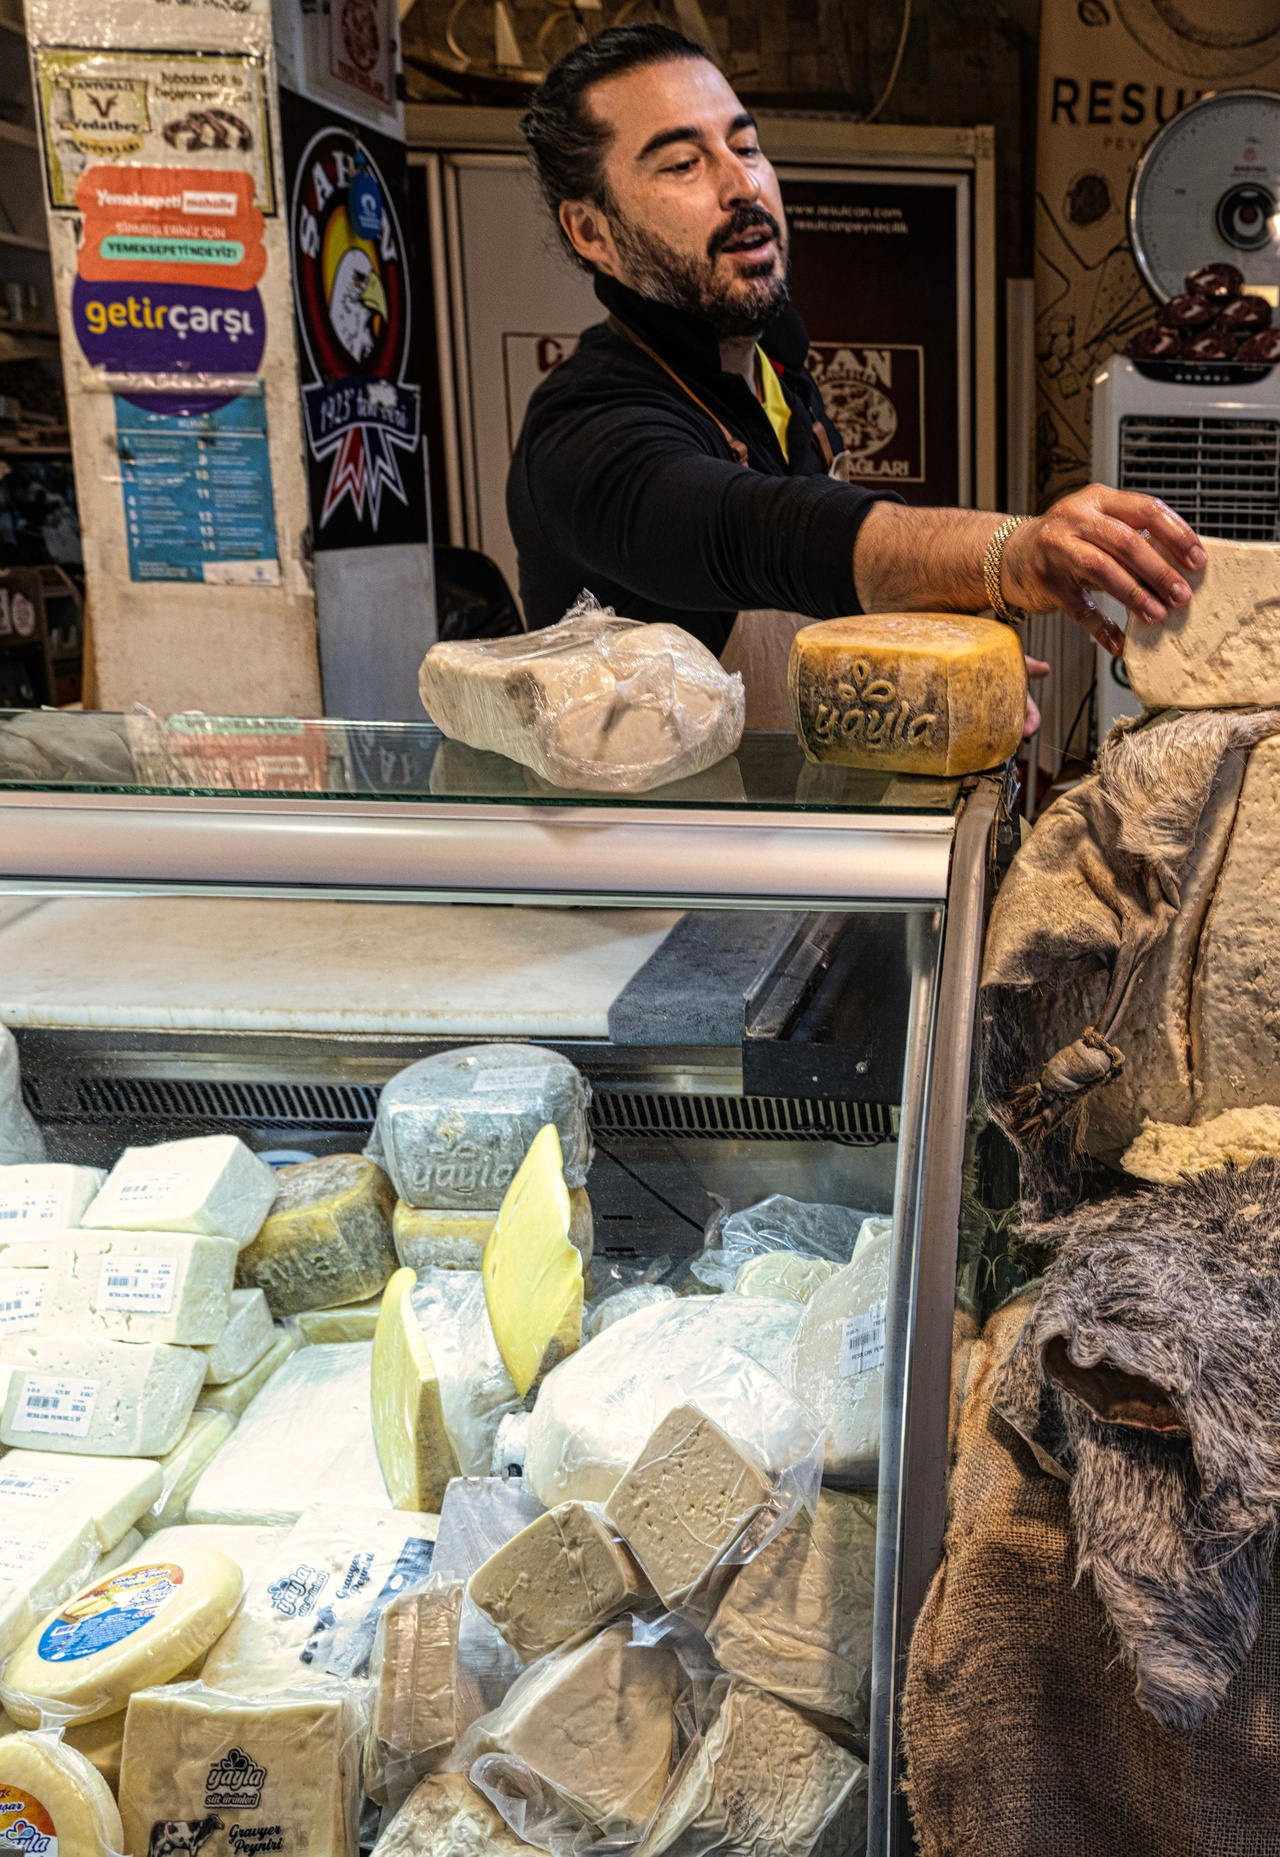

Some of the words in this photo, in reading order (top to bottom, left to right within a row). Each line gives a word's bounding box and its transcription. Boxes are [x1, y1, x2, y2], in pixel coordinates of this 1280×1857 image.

[1051, 77, 1203, 125] RESU
[97, 190, 182, 210] Yemeksepeti
[814, 700, 937, 750] yayla
[336, 1553, 361, 1600] Gravyer
[206, 1765, 264, 1791] yayla
[204, 1793, 222, 1806] süt
[222, 1793, 257, 1806] ürünleri
[229, 1824, 282, 1845] Gravyer
[234, 1837, 284, 1857] Peyniri
